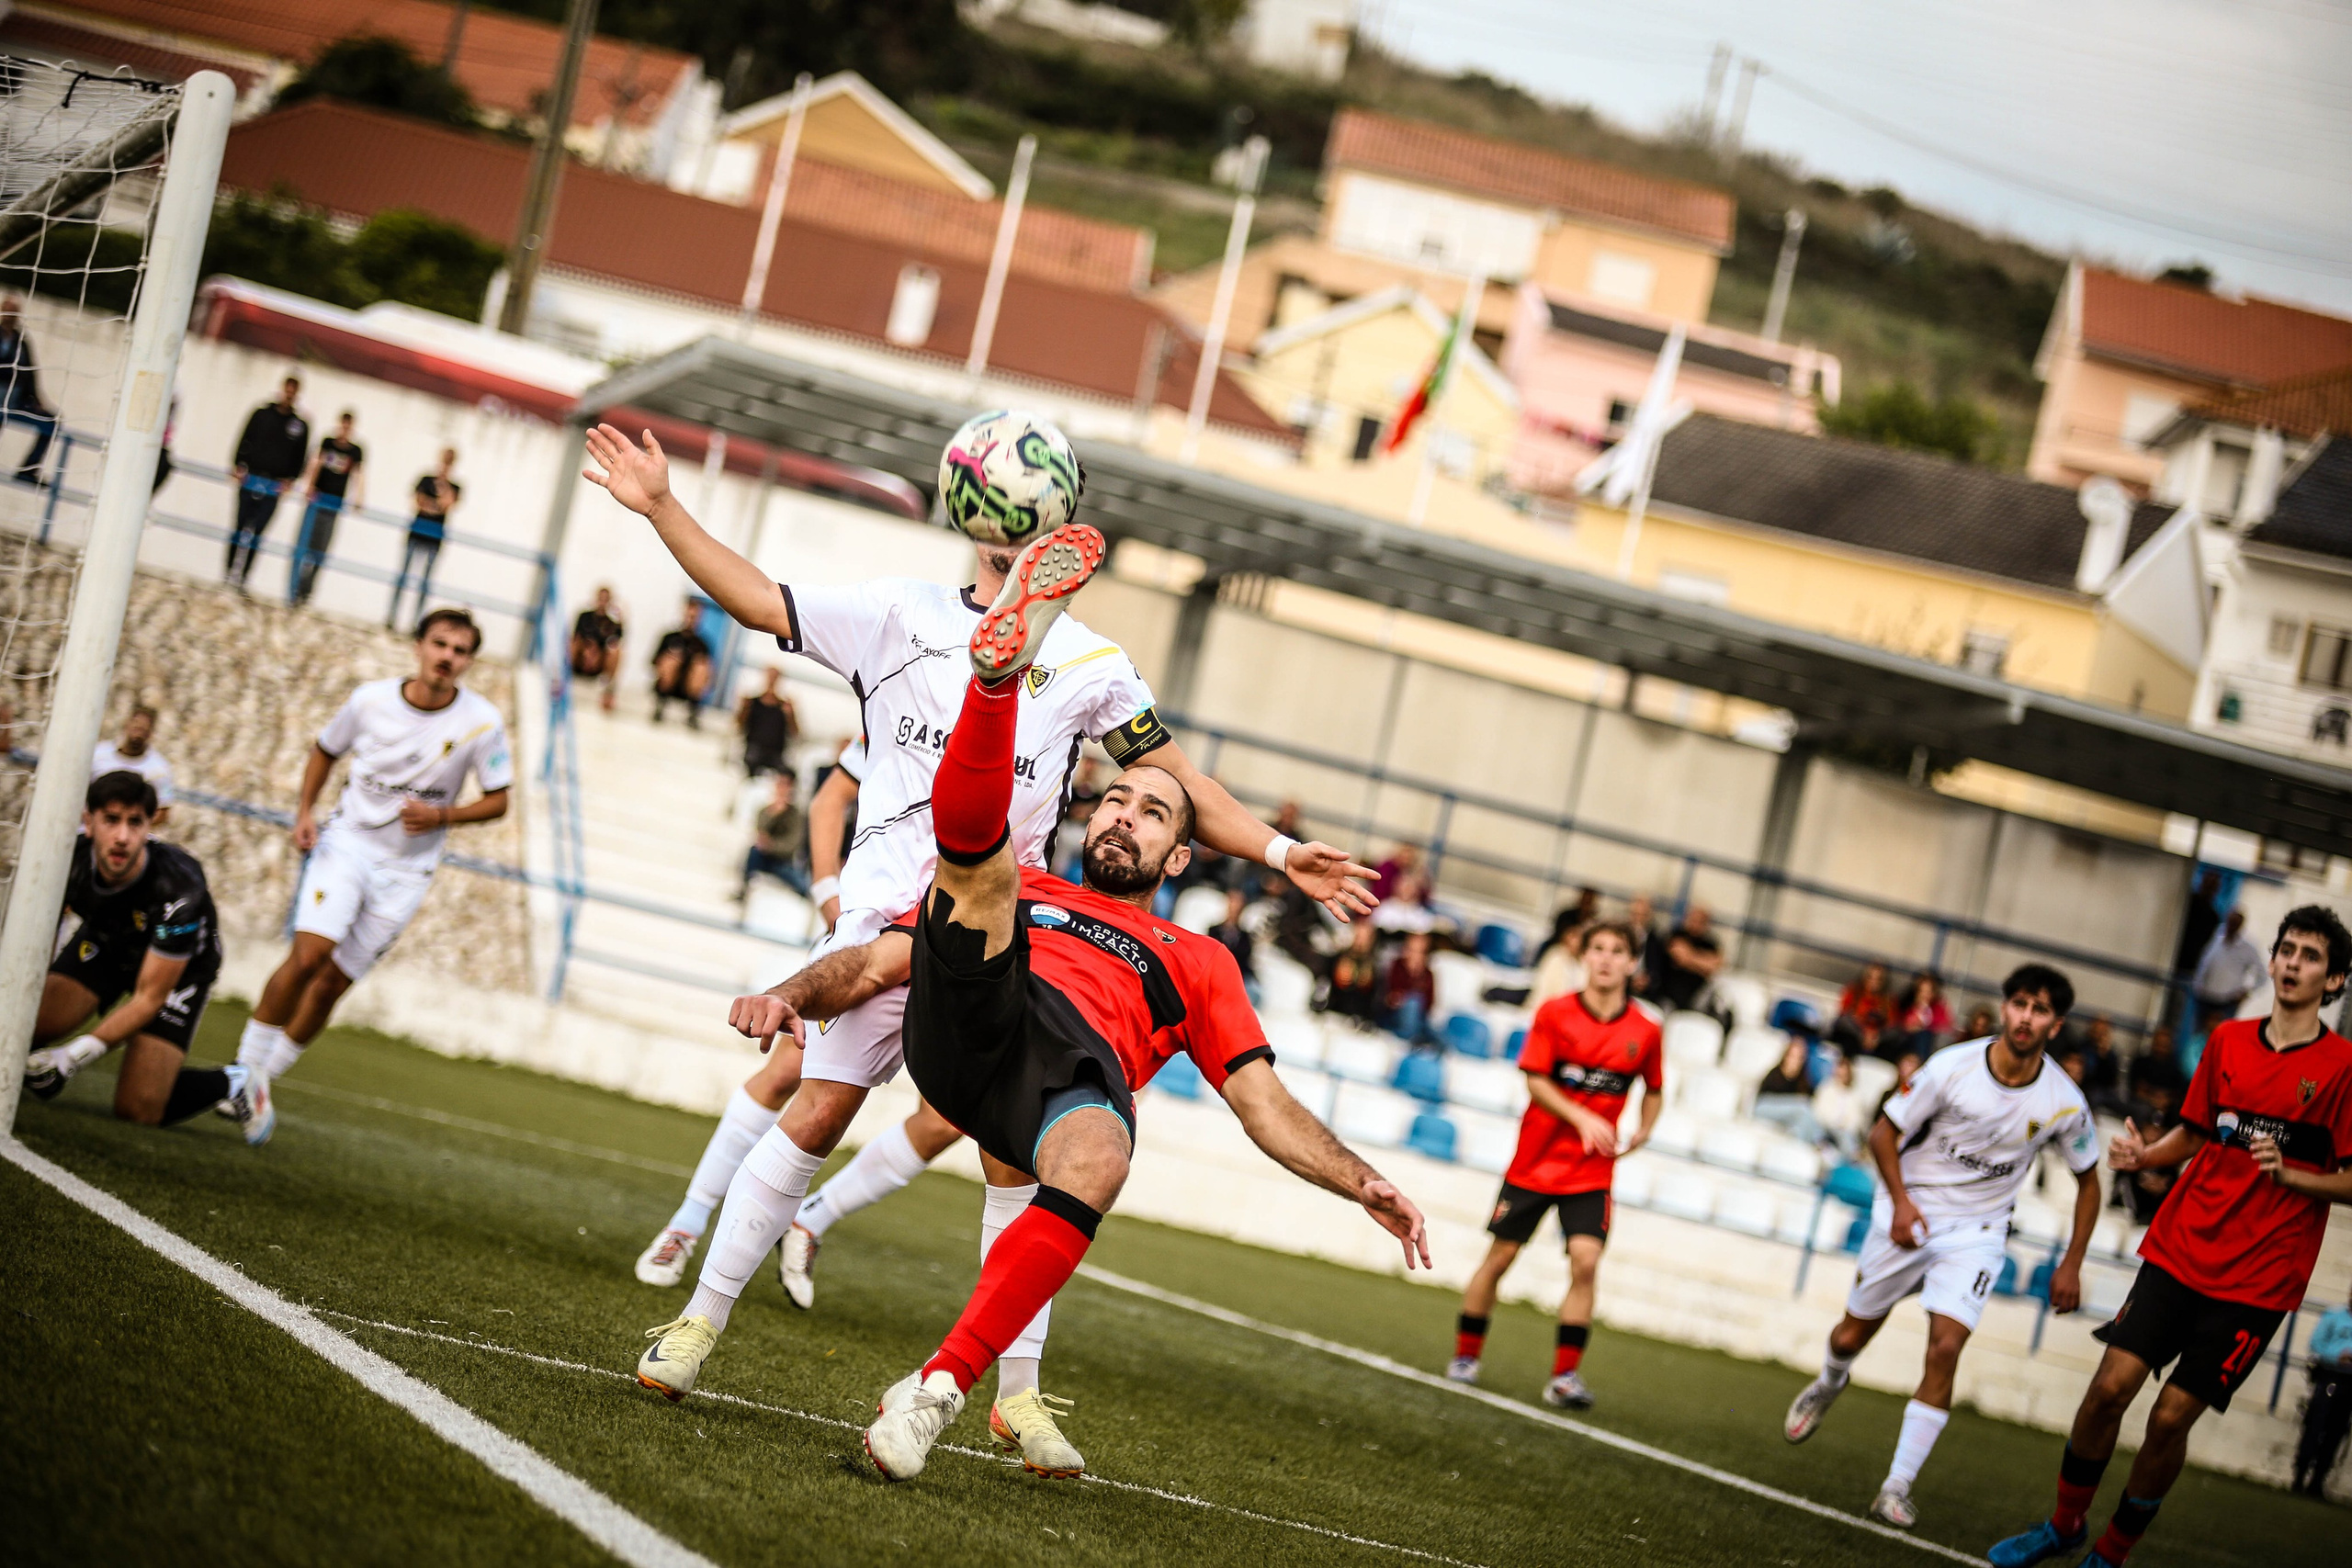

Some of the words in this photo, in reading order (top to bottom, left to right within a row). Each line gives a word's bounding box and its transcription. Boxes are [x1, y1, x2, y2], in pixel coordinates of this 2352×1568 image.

[1130, 711, 1152, 734] C
[1035, 908, 1066, 919] RE/MAX
[1071, 920, 1148, 973] IMPACTO
[1092, 924, 1139, 951] GRUPO
[1973, 1270, 1990, 1299] 8
